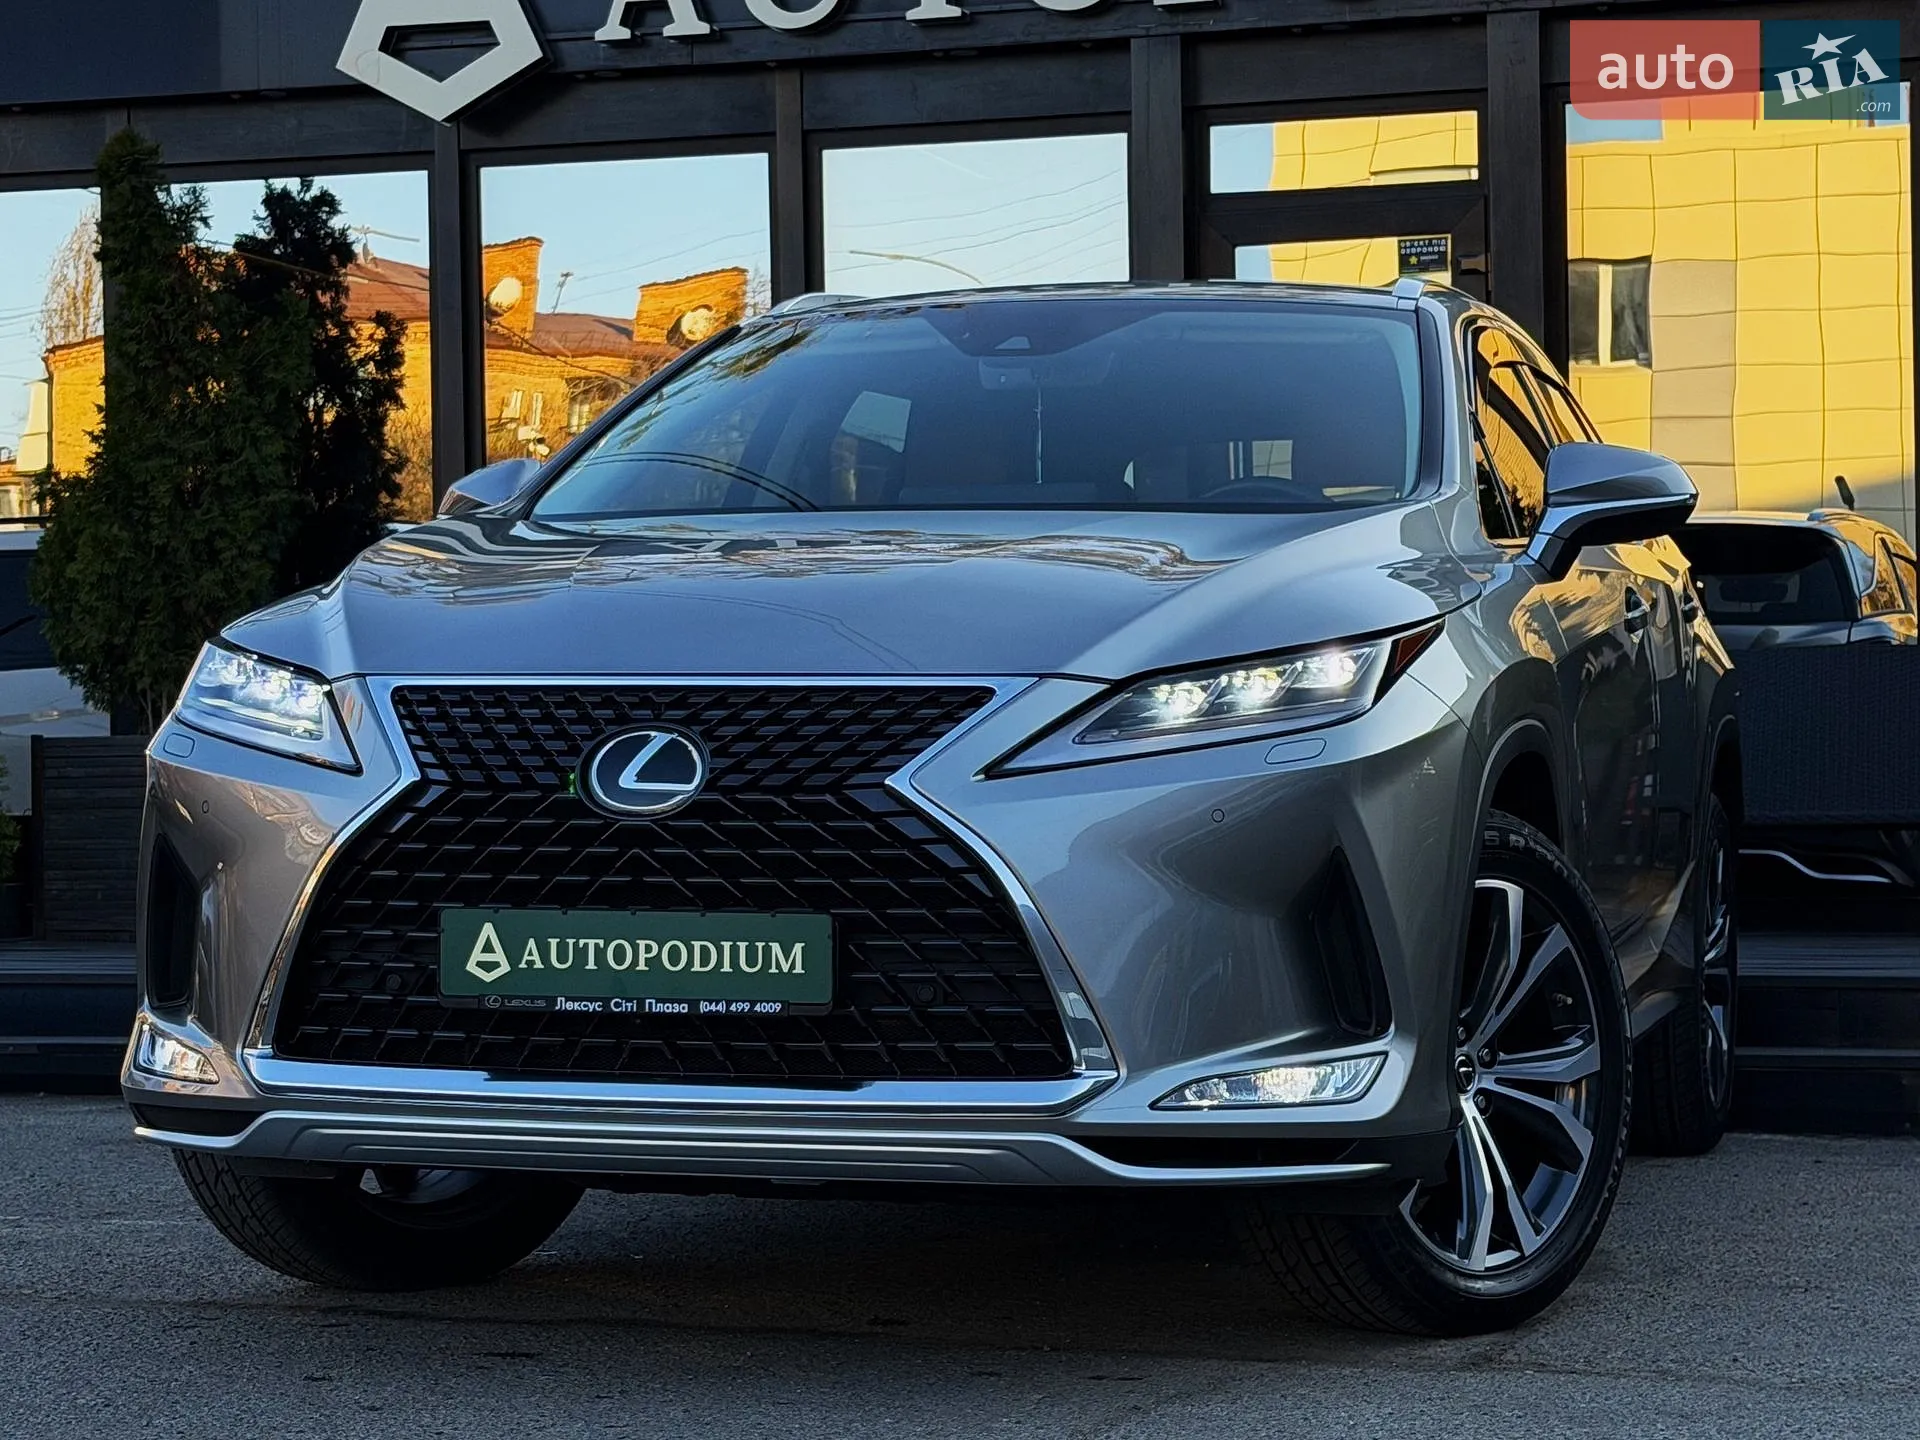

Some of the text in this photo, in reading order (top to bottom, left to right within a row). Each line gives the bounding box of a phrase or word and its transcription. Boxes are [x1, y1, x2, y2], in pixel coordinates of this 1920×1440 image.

[518, 937, 805, 974] AUTOPODIUM
[504, 998, 547, 1007] LEXUS
[554, 996, 782, 1014] Лексус Сіті Плаза (044) 499 4009
